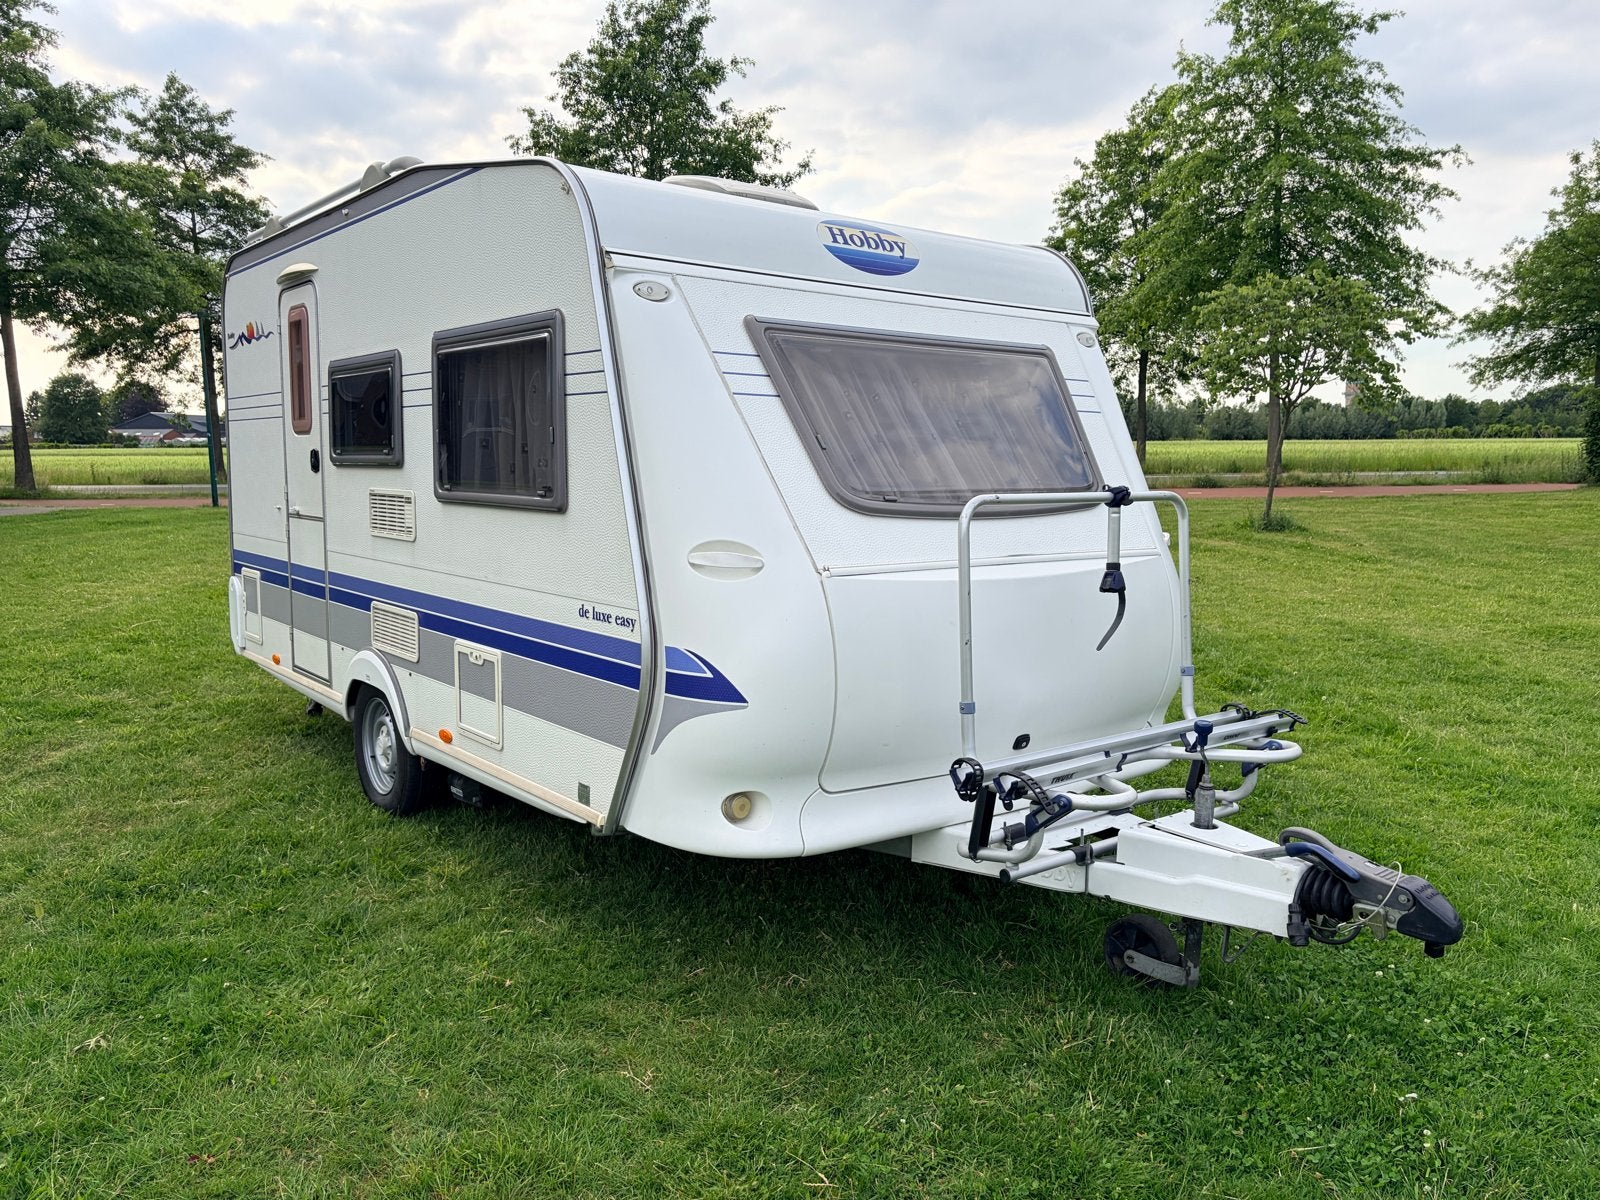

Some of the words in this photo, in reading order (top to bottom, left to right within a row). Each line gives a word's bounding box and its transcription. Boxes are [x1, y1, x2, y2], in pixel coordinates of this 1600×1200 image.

[825, 225, 906, 260] Hobby
[578, 603, 590, 619] de
[592, 606, 612, 624] luxe
[614, 615, 637, 632] easy
